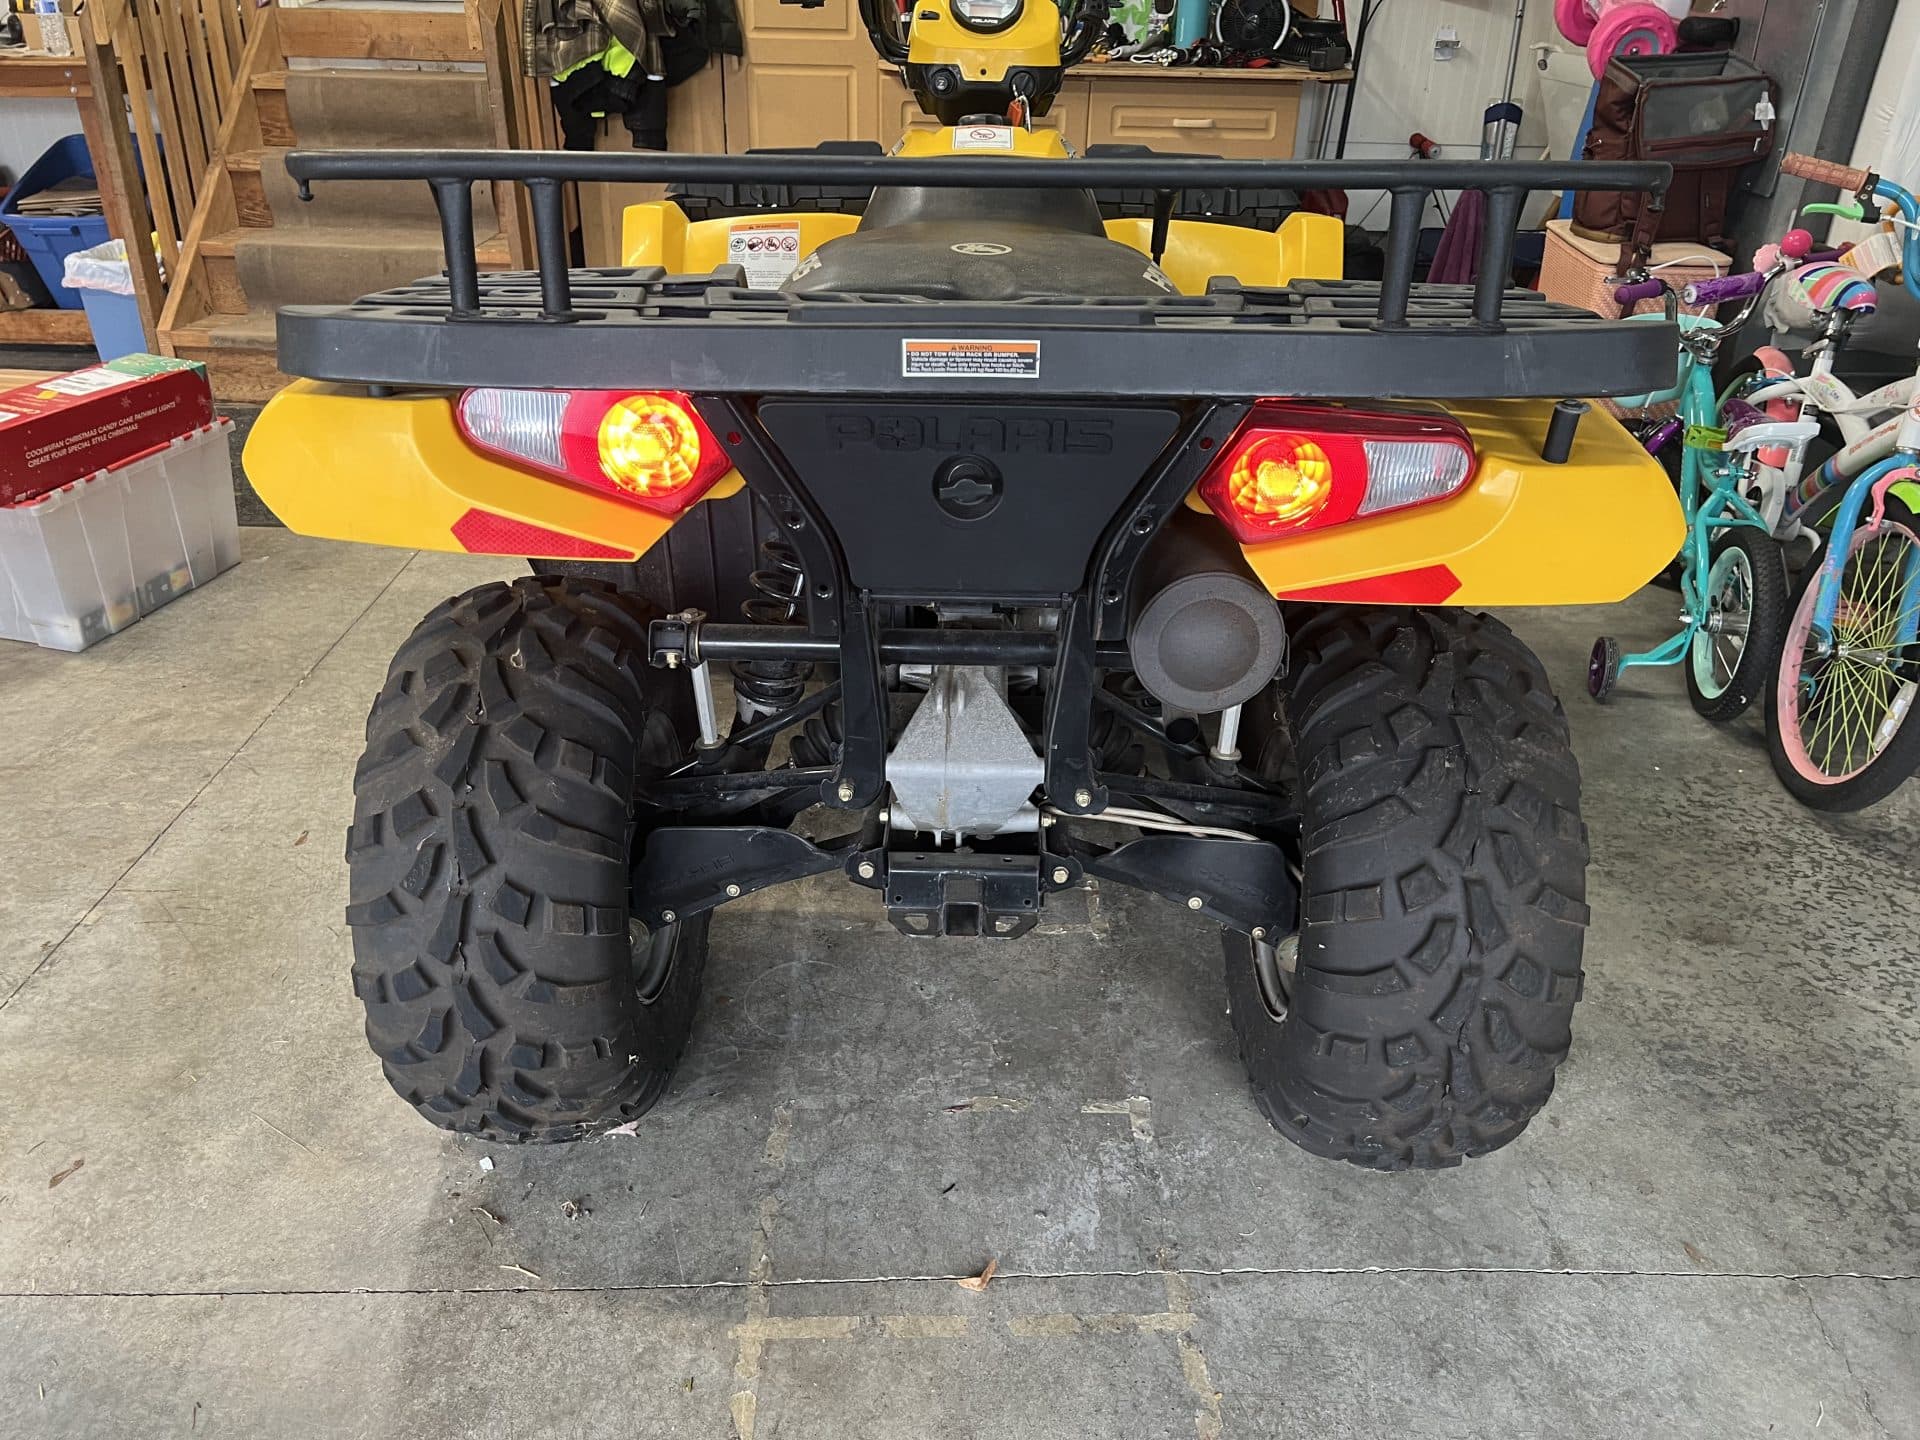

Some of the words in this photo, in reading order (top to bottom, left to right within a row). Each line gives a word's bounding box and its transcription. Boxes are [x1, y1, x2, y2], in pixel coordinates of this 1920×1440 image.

[65, 428, 98, 445] CHRISTMAS
[97, 421, 118, 434] CANDY
[118, 415, 134, 427] CANE
[134, 407, 158, 420] PATHWAY
[158, 401, 176, 413] LIGHTS
[825, 415, 1114, 454] POLARIS
[27, 455, 51, 468] CREATE
[51, 448, 67, 460] YOUR
[67, 440, 91, 454] SPECIAL
[91, 433, 107, 446] STYLE
[107, 423, 139, 439] CHRISTMAS
